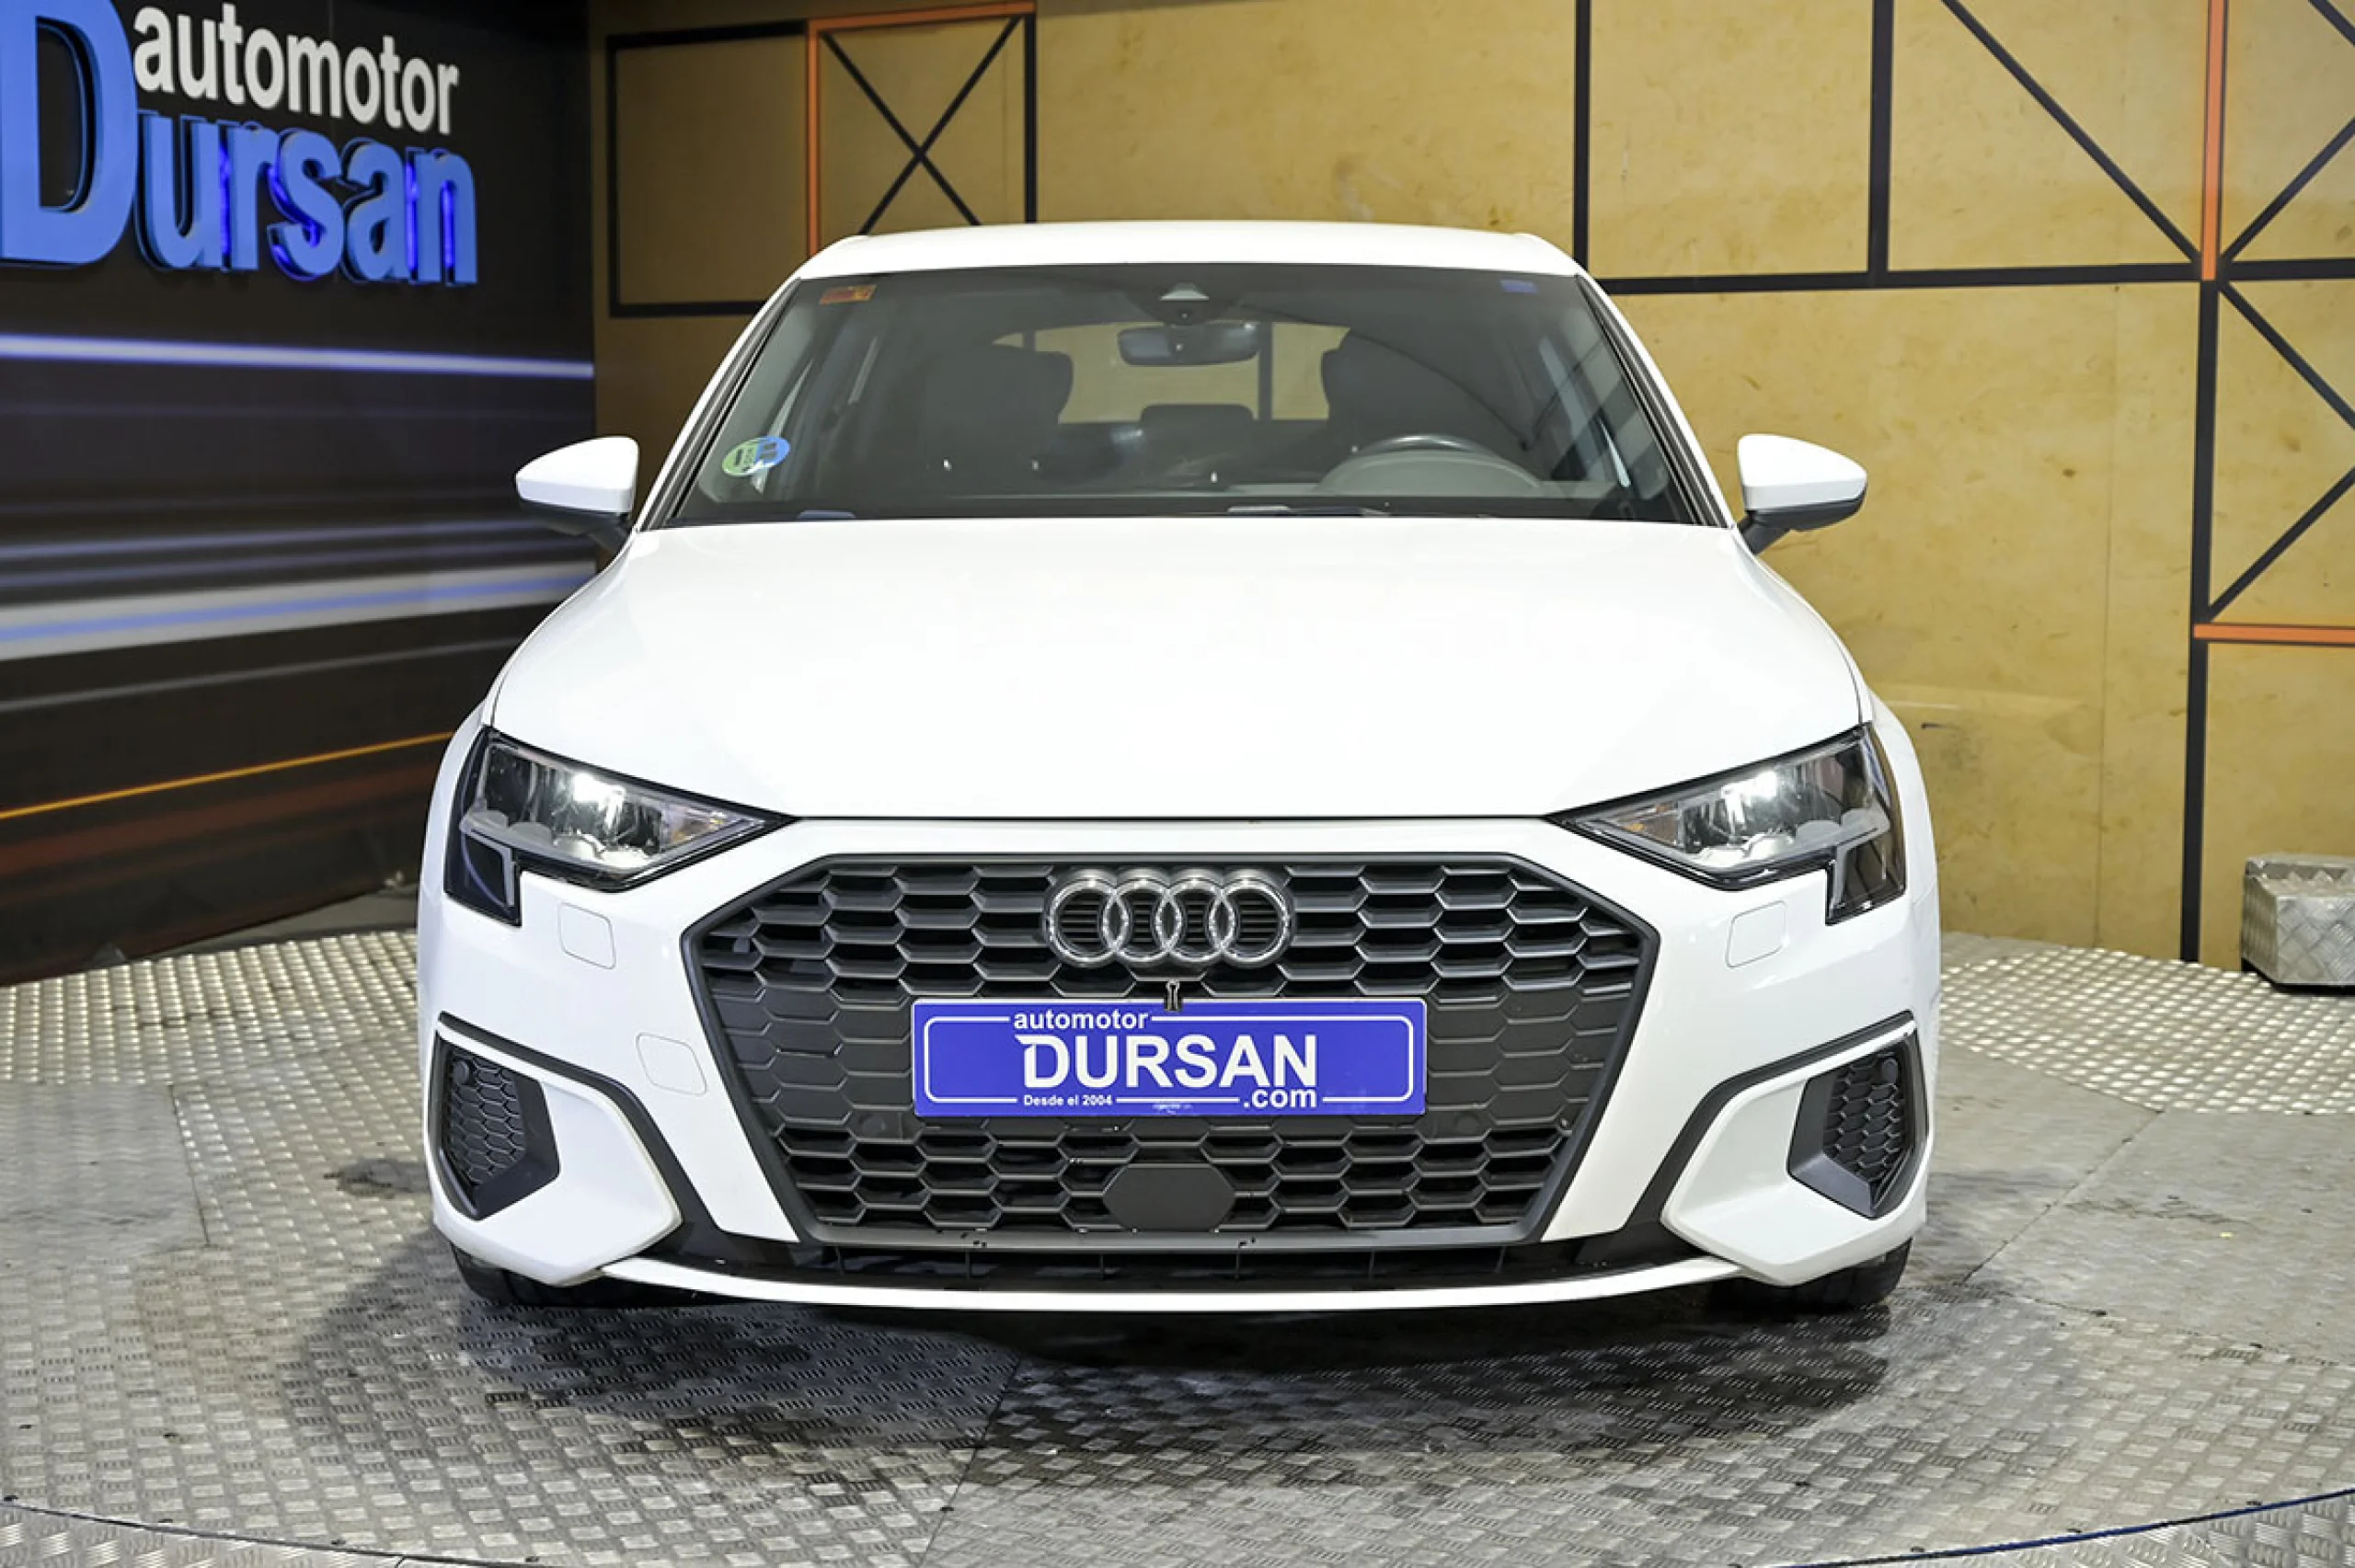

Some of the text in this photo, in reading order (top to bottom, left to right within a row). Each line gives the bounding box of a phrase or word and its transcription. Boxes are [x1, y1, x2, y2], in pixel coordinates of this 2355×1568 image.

[132, 3, 460, 134] automotor
[0, 0, 477, 286] Dursan
[1014, 1008, 1149, 1030] automotor
[1014, 1033, 1317, 1089] DURSAN
[1023, 1093, 1113, 1106] Desde el 2004
[1243, 1087, 1317, 1109] .com
